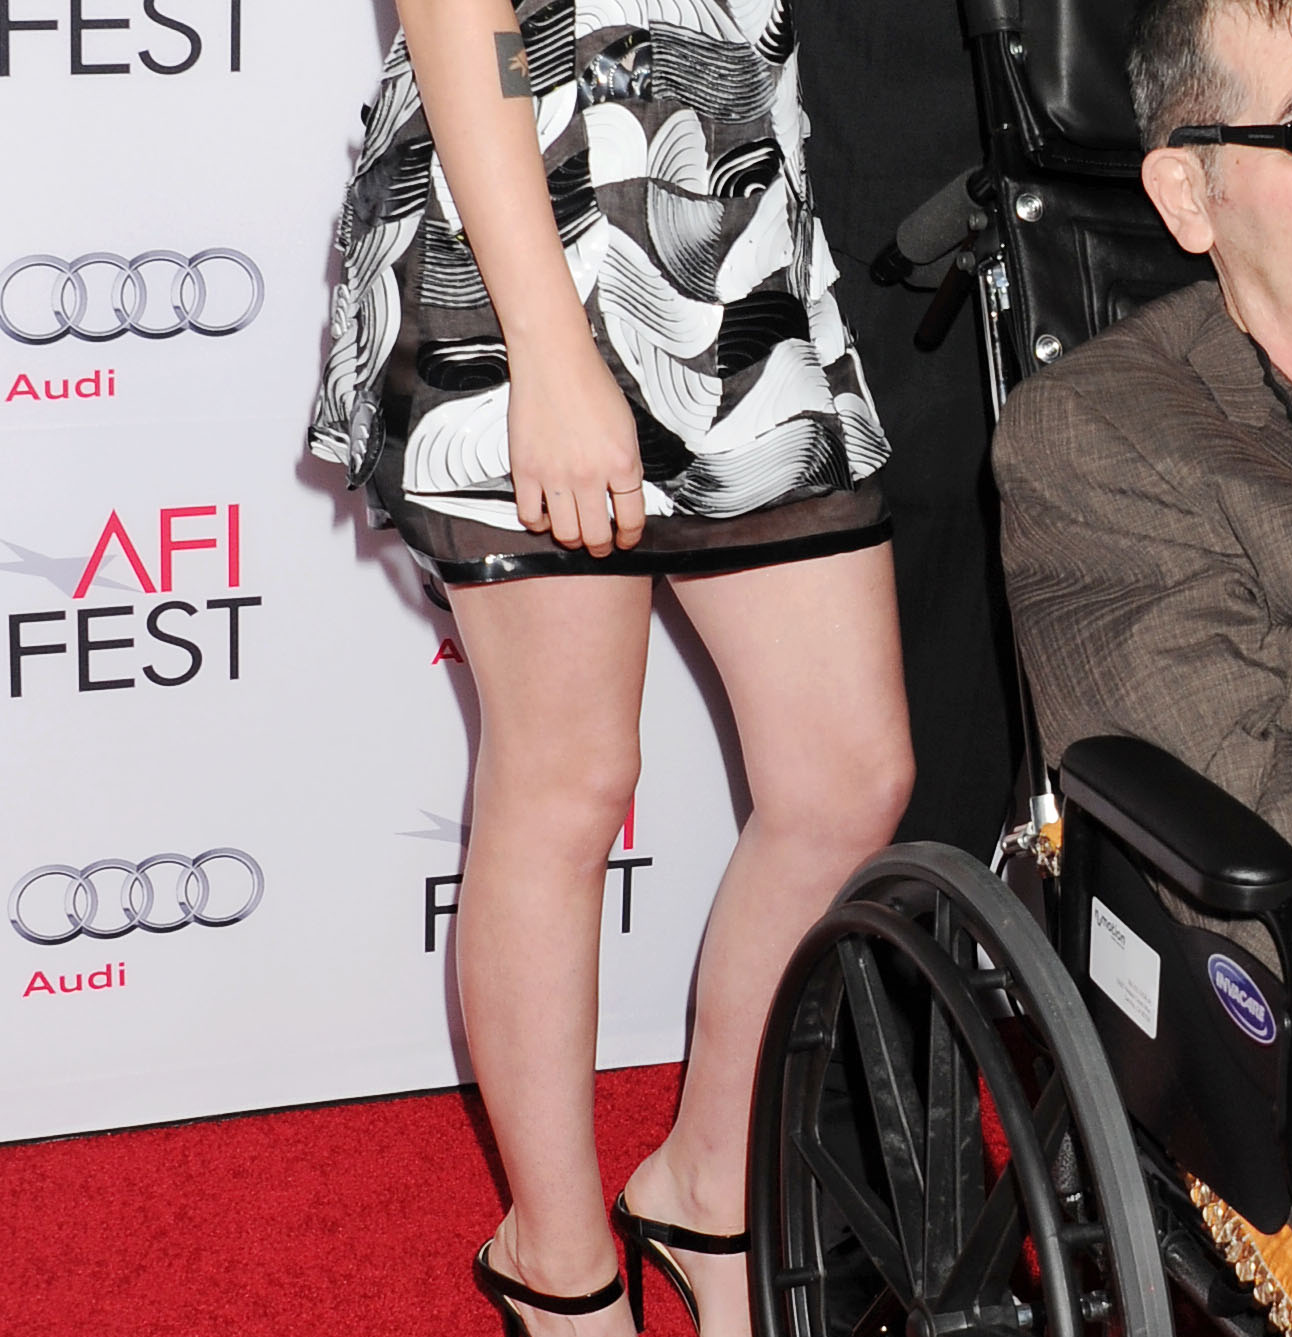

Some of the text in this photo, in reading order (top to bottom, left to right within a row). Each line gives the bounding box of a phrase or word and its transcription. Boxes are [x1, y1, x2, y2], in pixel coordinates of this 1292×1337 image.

[6, 370, 114, 402] Audi
[72, 504, 239, 599] AFI
[9, 596, 261, 697] FEST
[24, 963, 125, 997] Audi
[1215, 971, 1265, 1022] INVACARE
